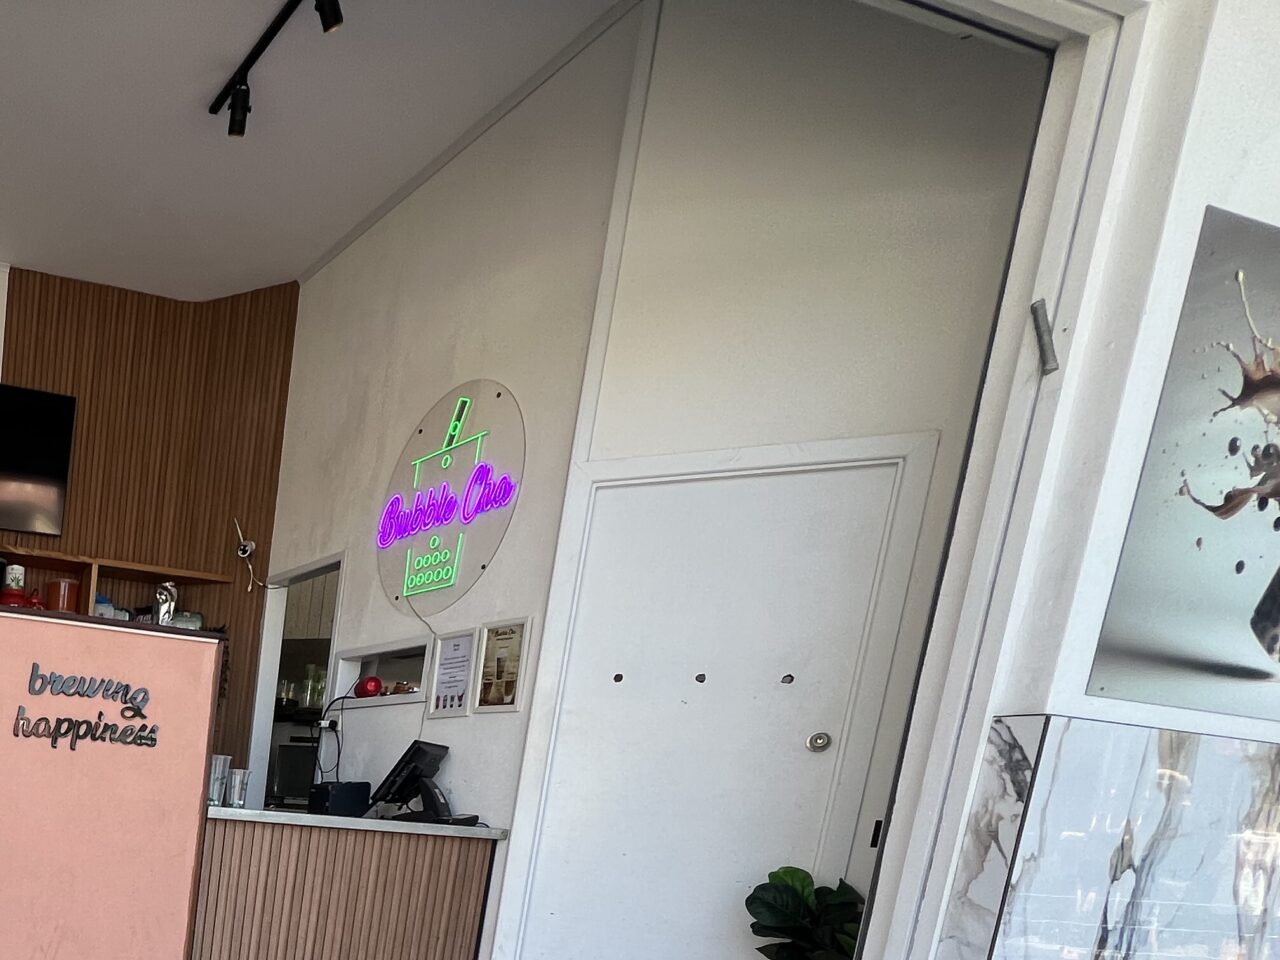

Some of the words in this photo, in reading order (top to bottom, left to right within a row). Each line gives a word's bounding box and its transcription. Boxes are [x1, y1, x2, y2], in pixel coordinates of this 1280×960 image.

[377, 482, 457, 548] Bubble
[461, 462, 515, 524] Cha
[28, 662, 150, 720] brewing
[13, 705, 159, 751] happiness
